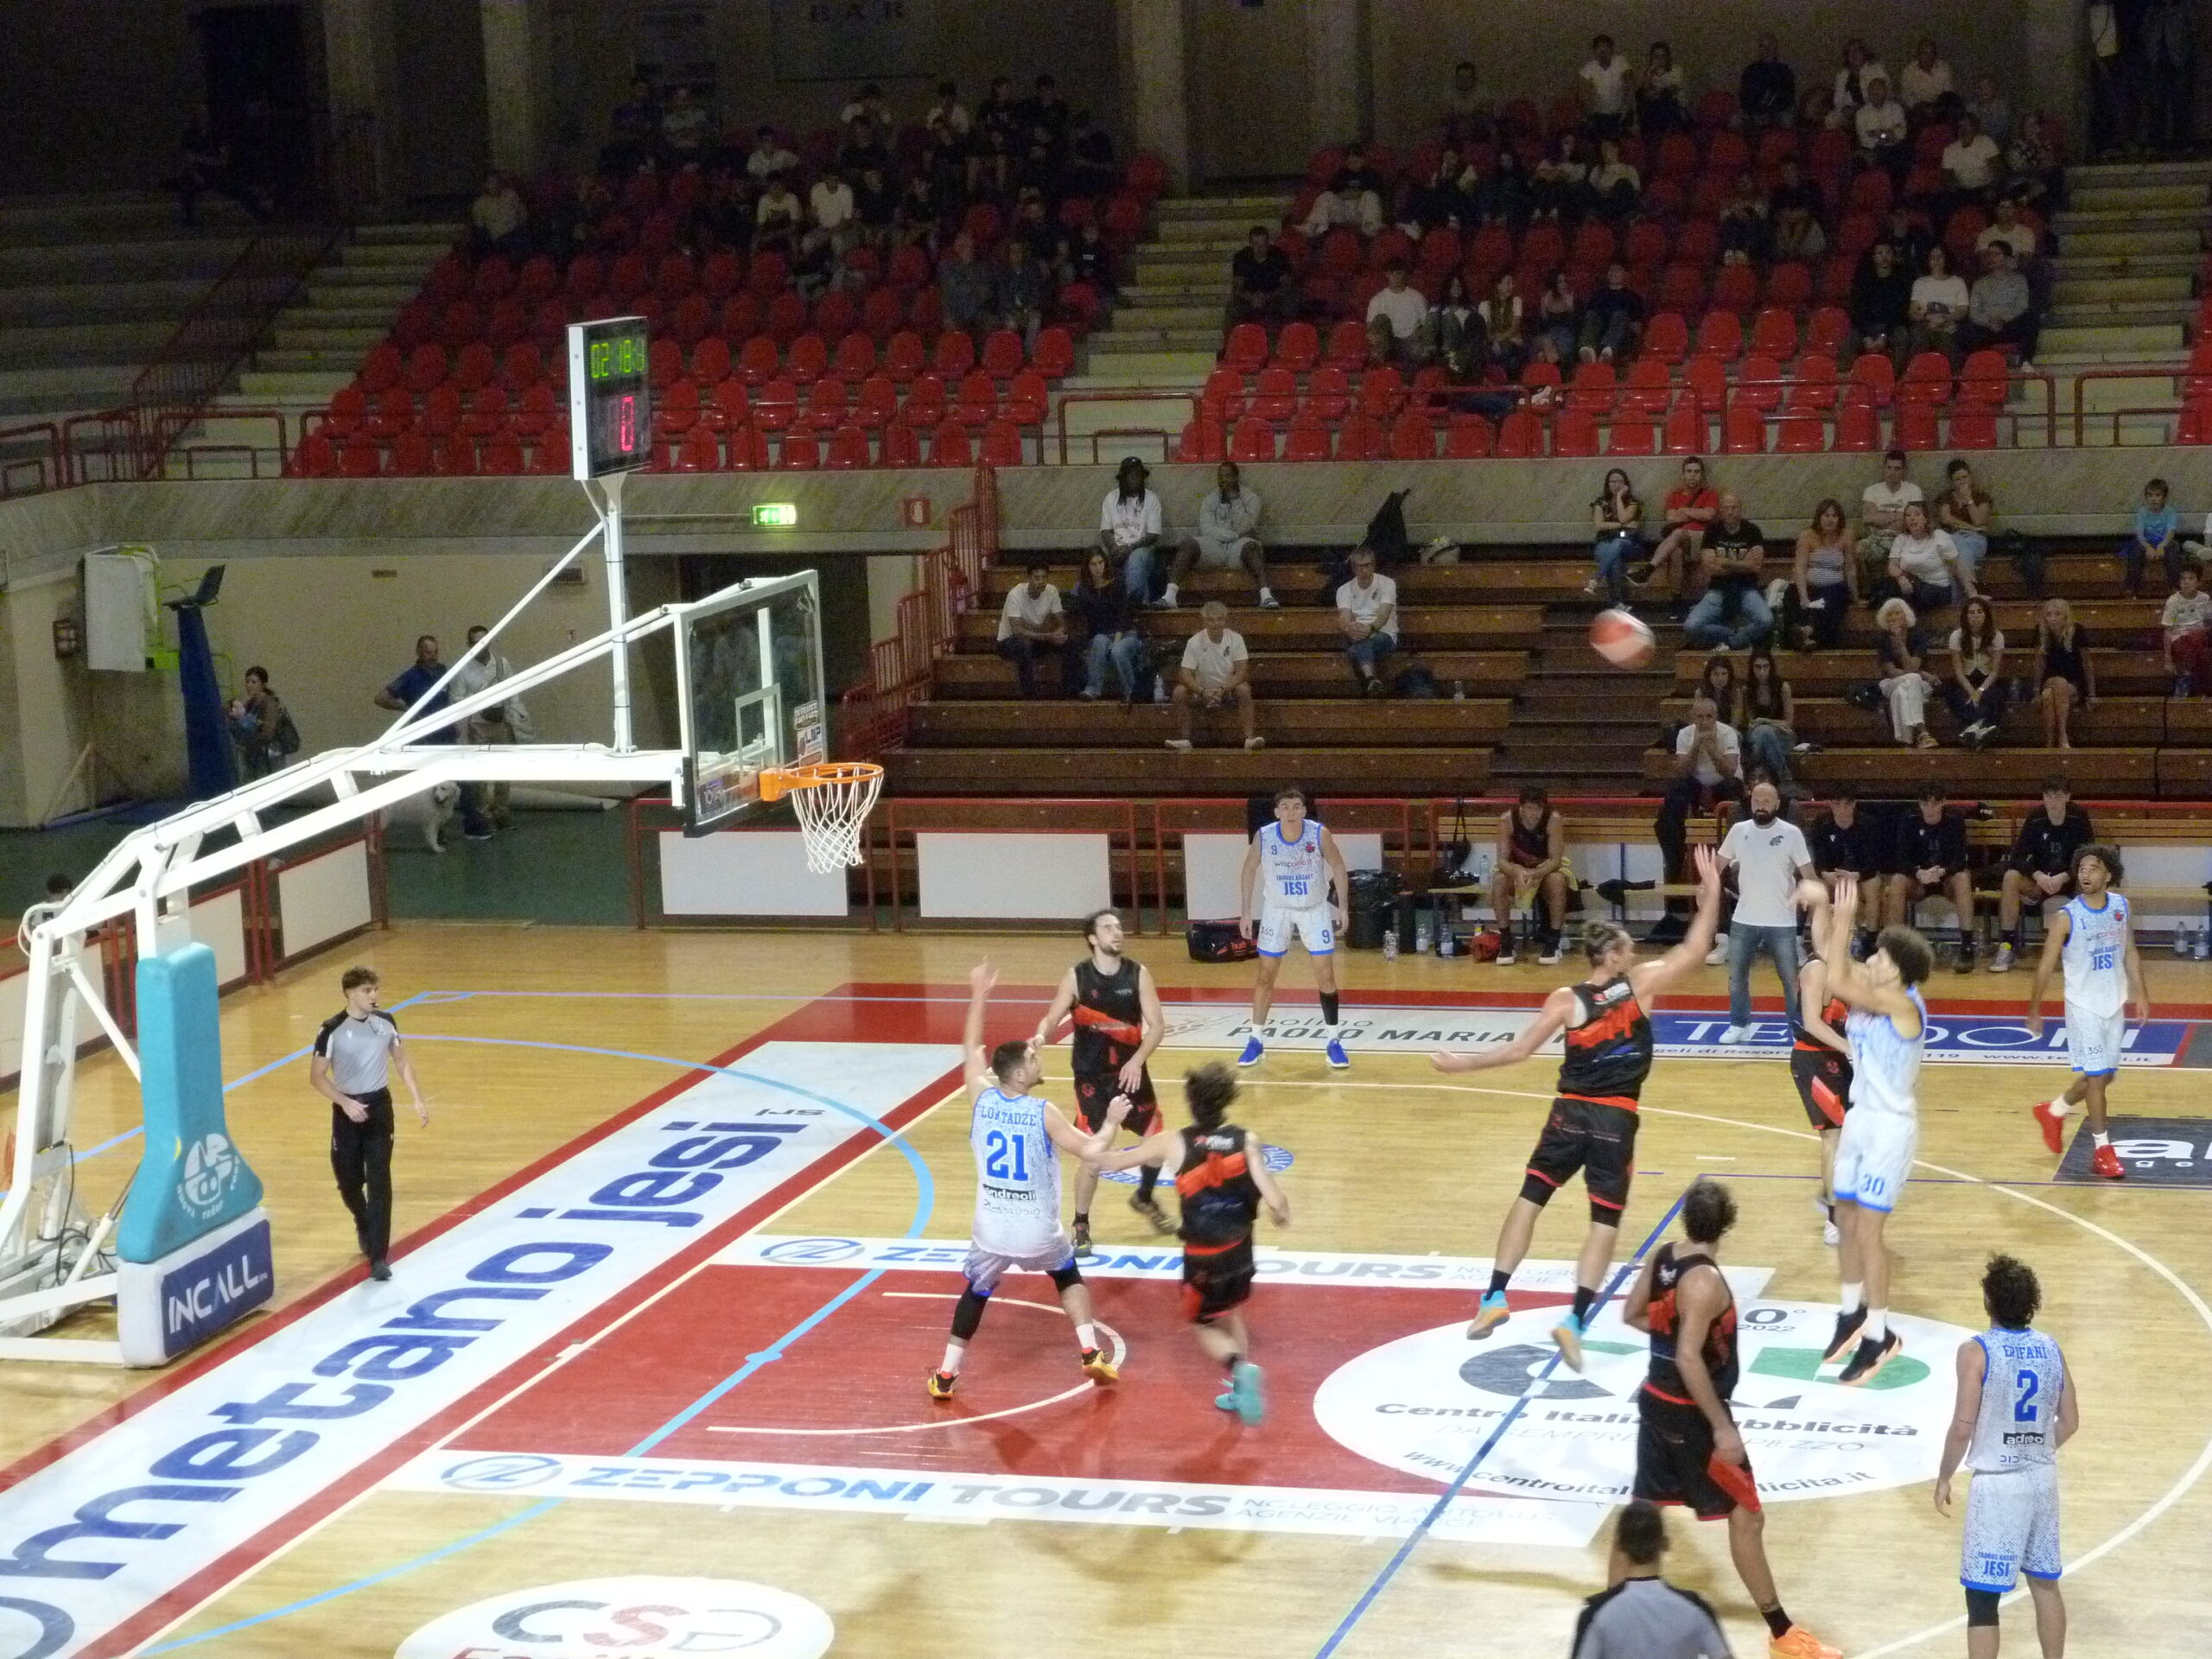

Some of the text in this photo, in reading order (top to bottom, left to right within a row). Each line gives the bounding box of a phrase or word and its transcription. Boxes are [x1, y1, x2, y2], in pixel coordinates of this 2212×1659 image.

[1271, 844, 1278, 855] 9
[1284, 881, 1308, 896] JESI
[1321, 929, 1331, 944] 9
[2092, 953, 2113, 971] JES
[1226, 1027, 1364, 1039] PAOLO
[1376, 1028, 1516, 1043] MARIA
[986, 1129, 1028, 1181] 21
[513, 1121, 809, 1228] jesi
[1860, 1173, 1885, 1196] 30
[871, 1245, 1446, 1281] ZEONI OURS
[168, 1255, 259, 1335] INCALL
[2003, 1344, 2049, 1360] EPIFANI
[2013, 1369, 2039, 1422] 2
[1375, 1403, 1919, 1437] Centro Itali bblicità
[568, 1466, 1232, 1517] ZEPPONI TOURS
[1983, 1560, 2010, 1578] JESI
